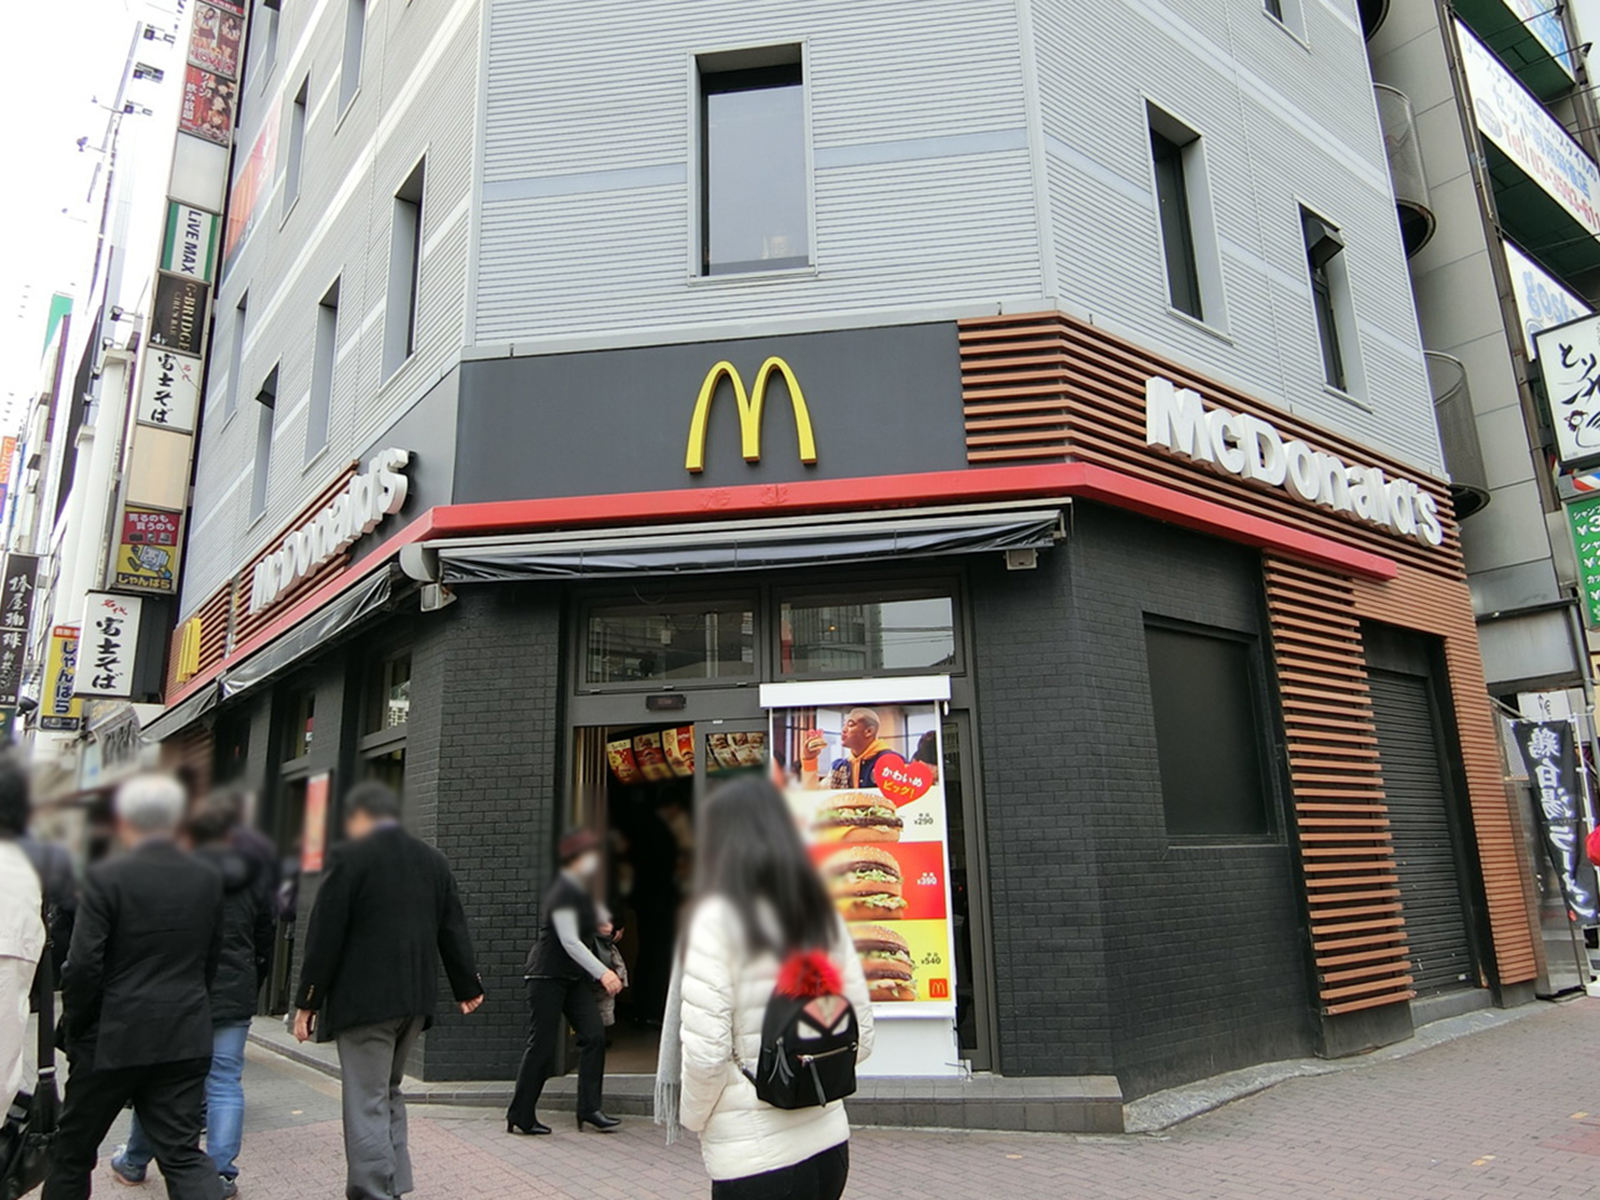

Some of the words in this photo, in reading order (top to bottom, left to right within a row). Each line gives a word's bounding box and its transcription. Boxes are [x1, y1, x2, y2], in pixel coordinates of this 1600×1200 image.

[181, 241, 198, 275] MAX
[150, 353, 175, 423] 富士そば
[1145, 375, 1444, 547] McDonald's
[92, 616, 124, 689] 富士そば
[881, 766, 923, 787] かわいめ
[914, 817, 934, 826] ¥290
[920, 956, 942, 965] ¥540
